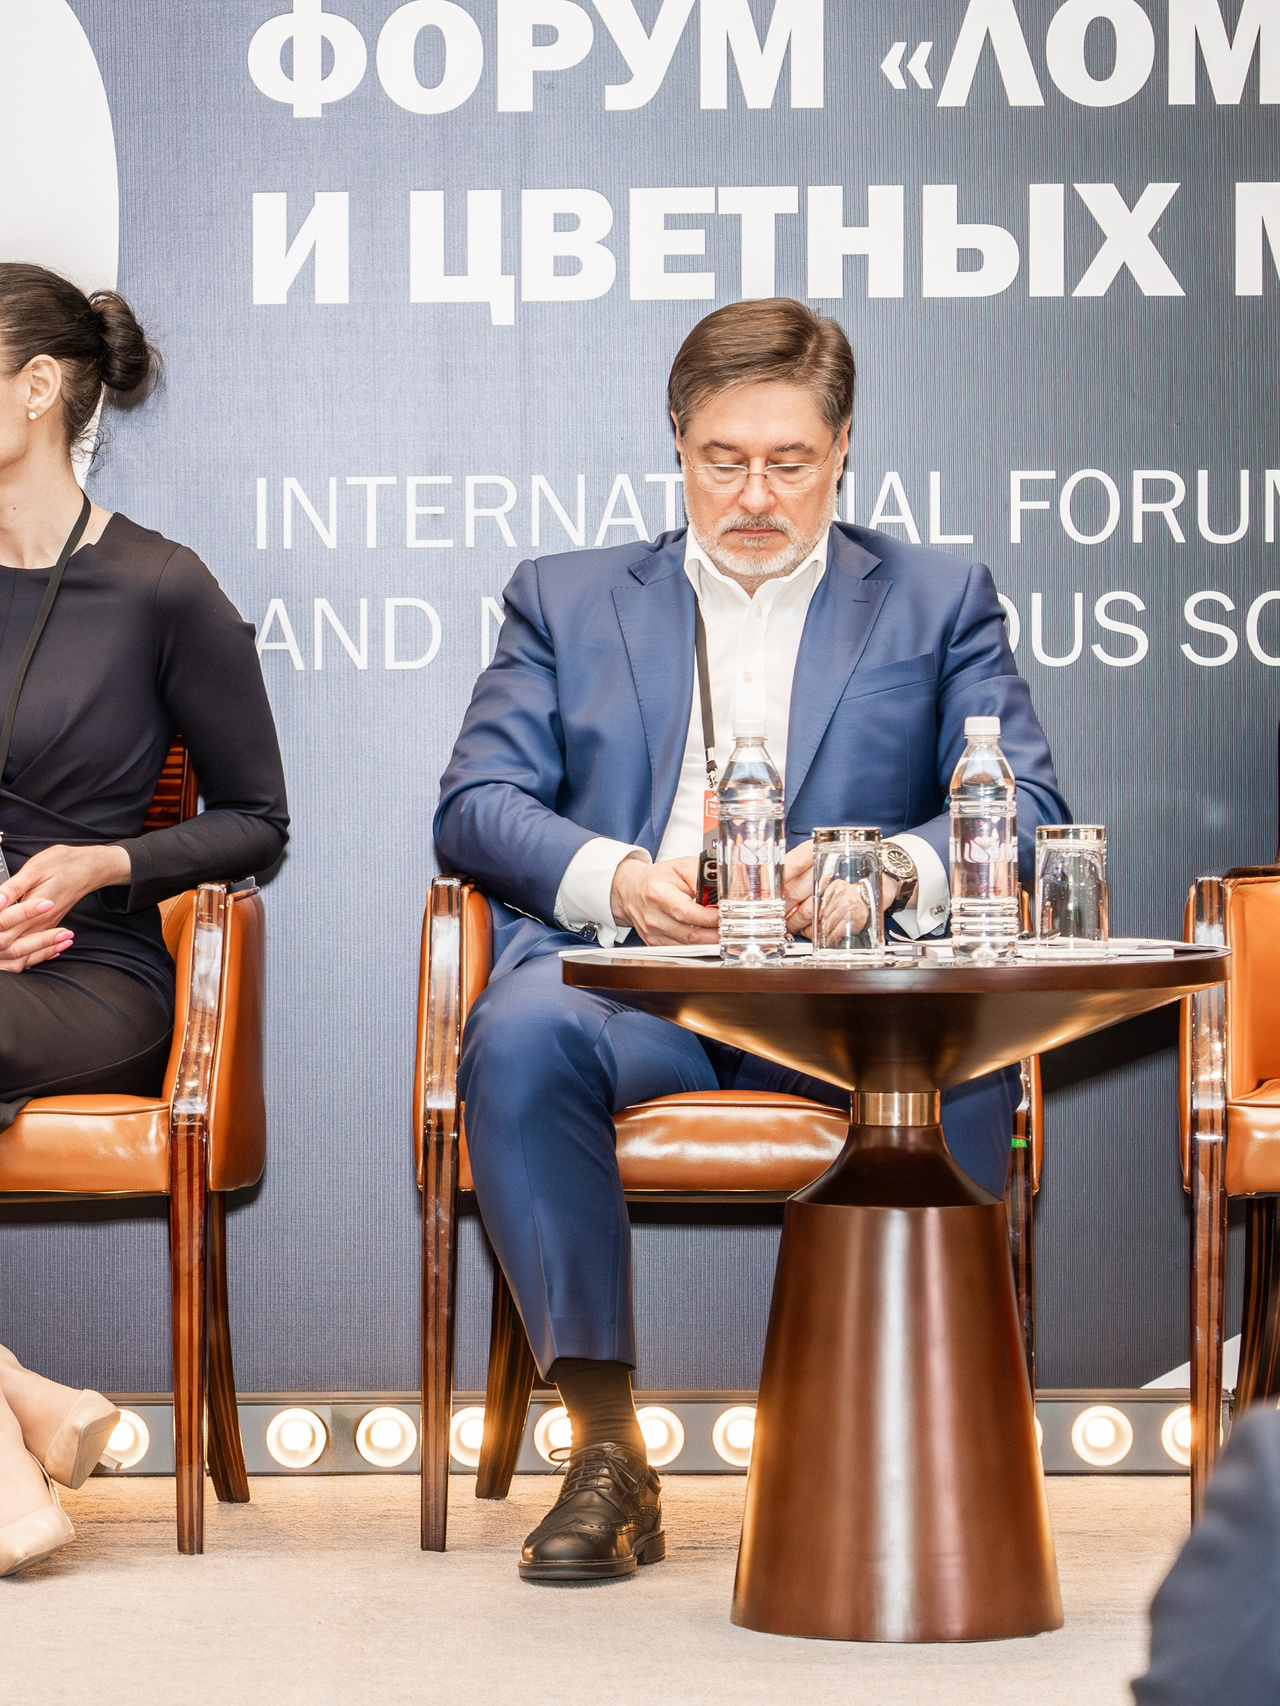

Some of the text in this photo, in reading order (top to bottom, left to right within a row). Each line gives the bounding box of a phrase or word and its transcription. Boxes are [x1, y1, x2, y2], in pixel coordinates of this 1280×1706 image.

[247, 0, 824, 118] ФОРУМ
[252, 191, 349, 305] И
[409, 182, 1186, 326] ЦВЕТНЫХ
[256, 468, 1280, 550] INTERNATAL FORU
[255, 597, 443, 671] AND
